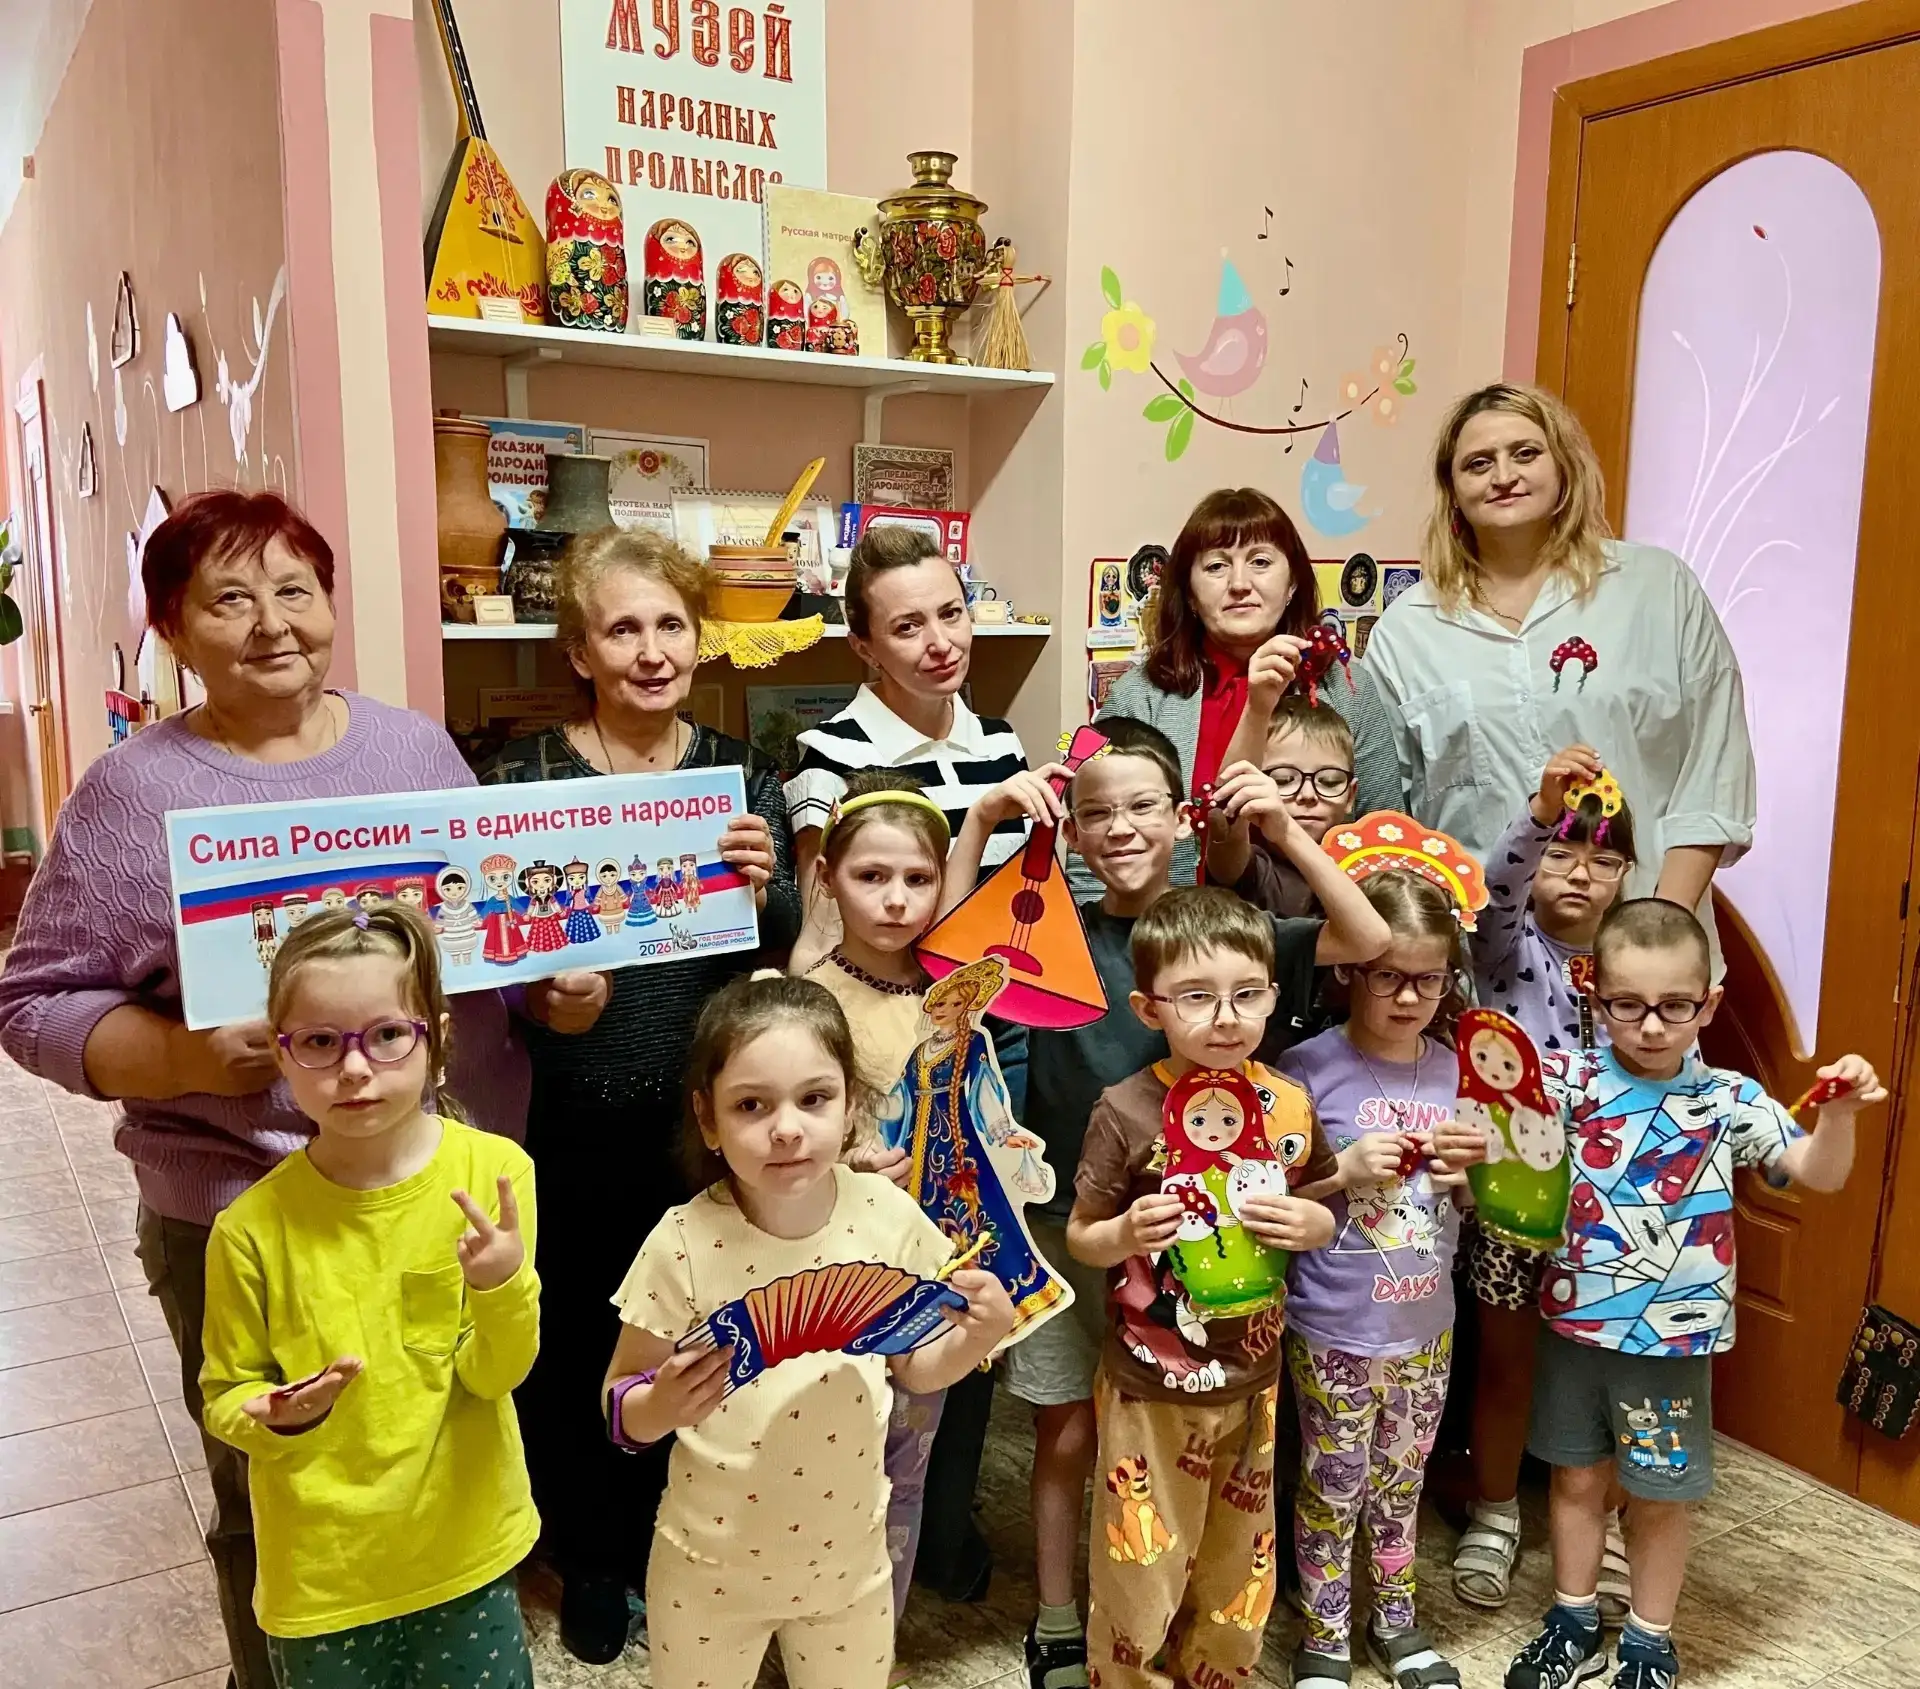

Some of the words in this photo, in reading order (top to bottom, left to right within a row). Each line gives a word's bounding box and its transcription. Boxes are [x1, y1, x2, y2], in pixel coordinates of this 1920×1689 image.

[616, 85, 778, 149] НАРОДНЫХ
[781, 225, 819, 237] Русская
[491, 440, 545, 454] СКАЗКИ
[884, 470, 929, 480] ПРЕДМЕТЫ
[868, 481, 920, 492] НАРОДНОГО
[189, 834, 279, 864] Сила
[290, 824, 411, 854] России
[449, 819, 467, 839] в
[476, 805, 612, 840] единстве
[622, 794, 732, 826] народов
[699, 940, 729, 948] НАРОДОВ
[730, 936, 756, 944] РОССИИ
[712, 931, 745, 941] ЕДИНСТВА
[639, 943, 672, 957] 2026
[1357, 1099, 1448, 1131] SUNNY
[1374, 1274, 1440, 1302] DAYS
